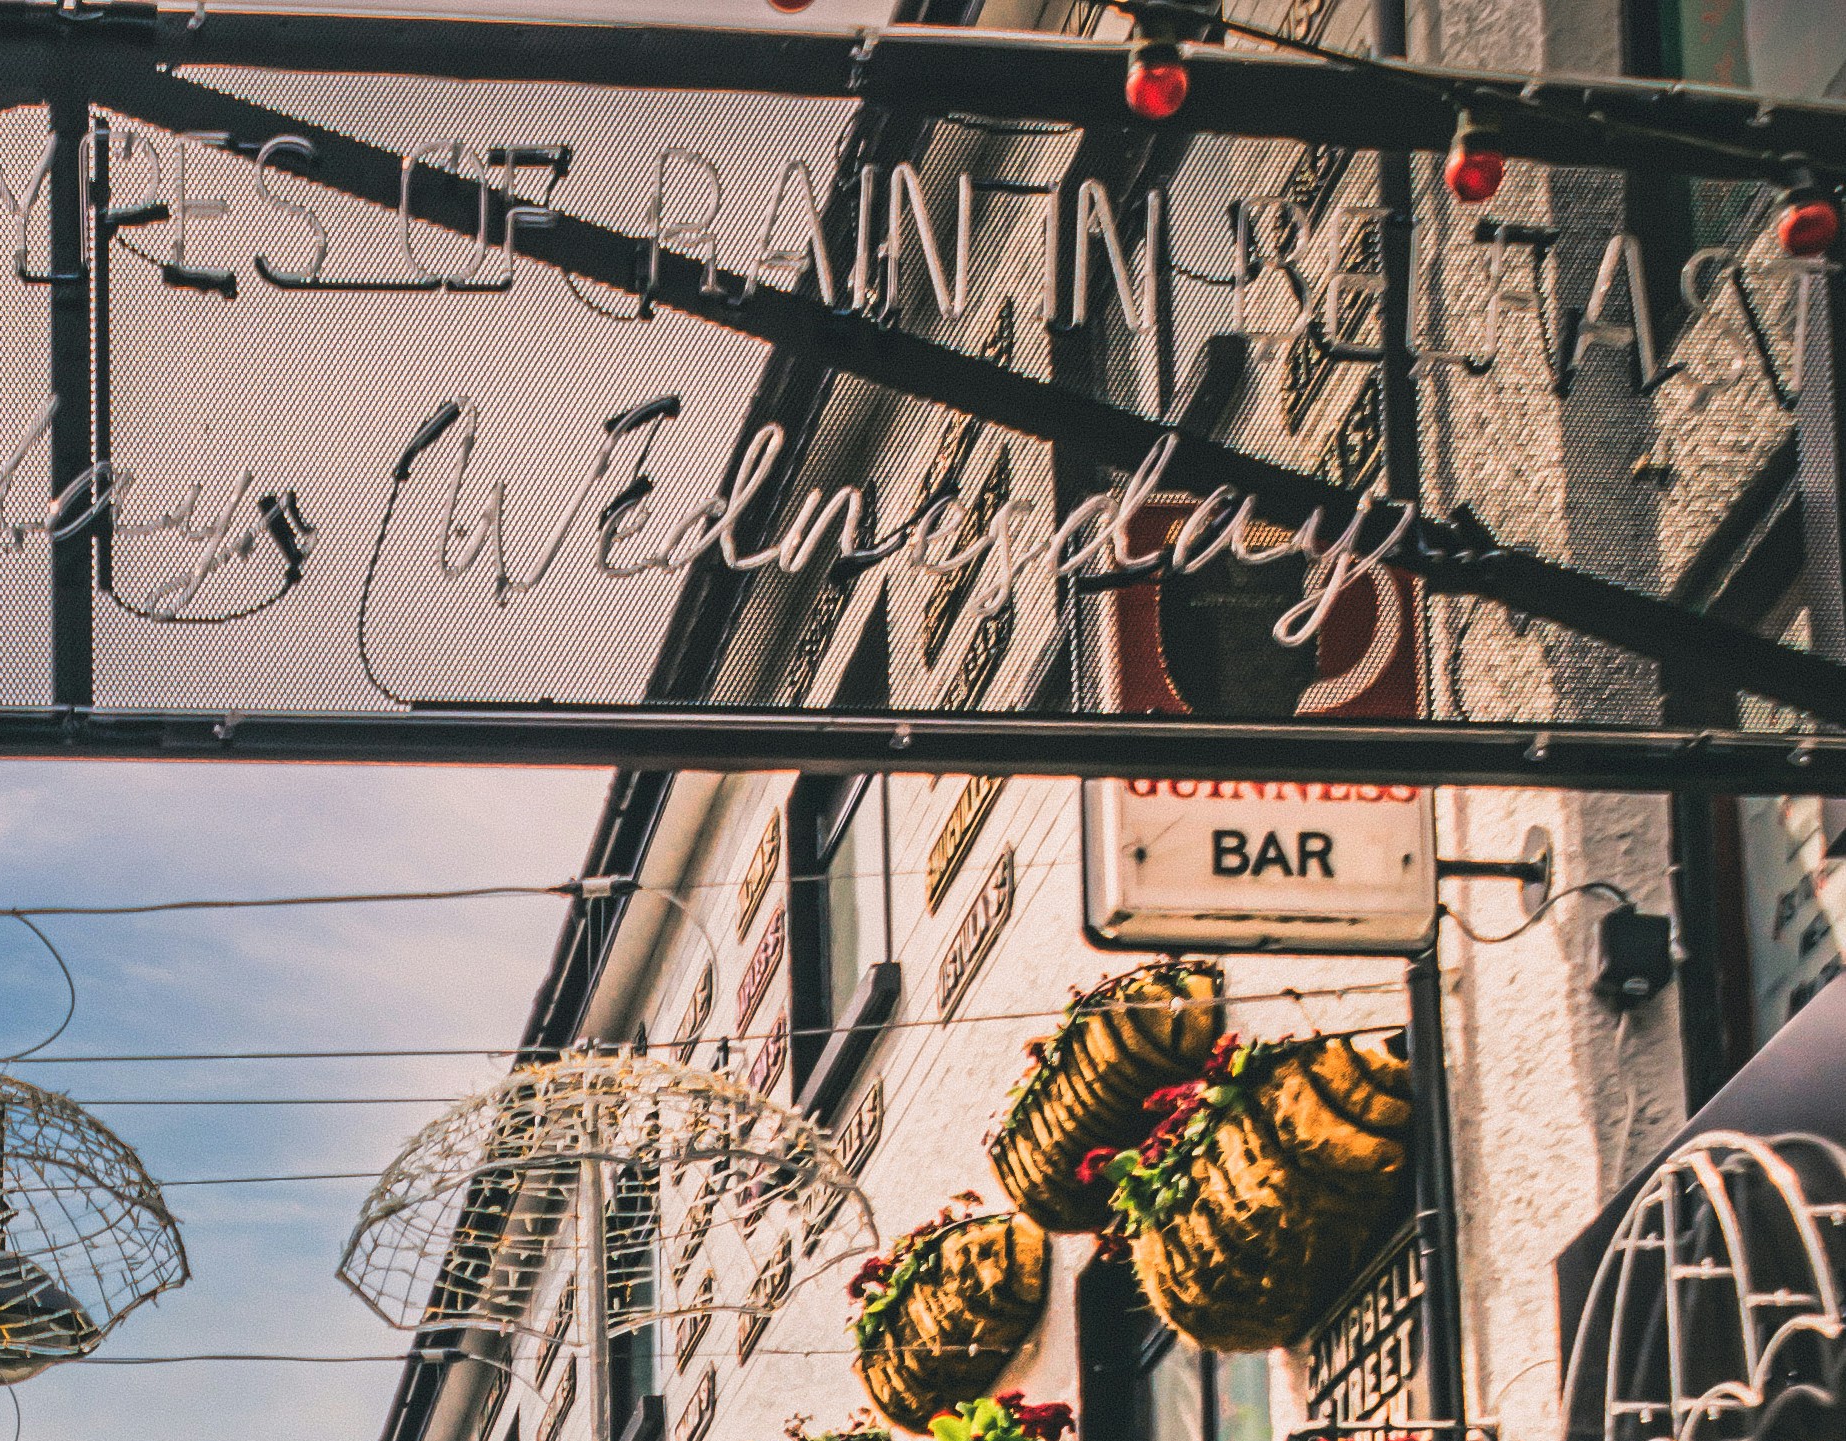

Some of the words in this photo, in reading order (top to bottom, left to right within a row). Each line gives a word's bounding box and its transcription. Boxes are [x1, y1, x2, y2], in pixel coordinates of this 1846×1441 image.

[400, 140, 564, 290] OF
[650, 145, 964, 322] RAIN
[1042, 178, 1158, 335] IN
[1234, 195, 1840, 408] BELFAST
[1212, 829, 1335, 878] BAR
